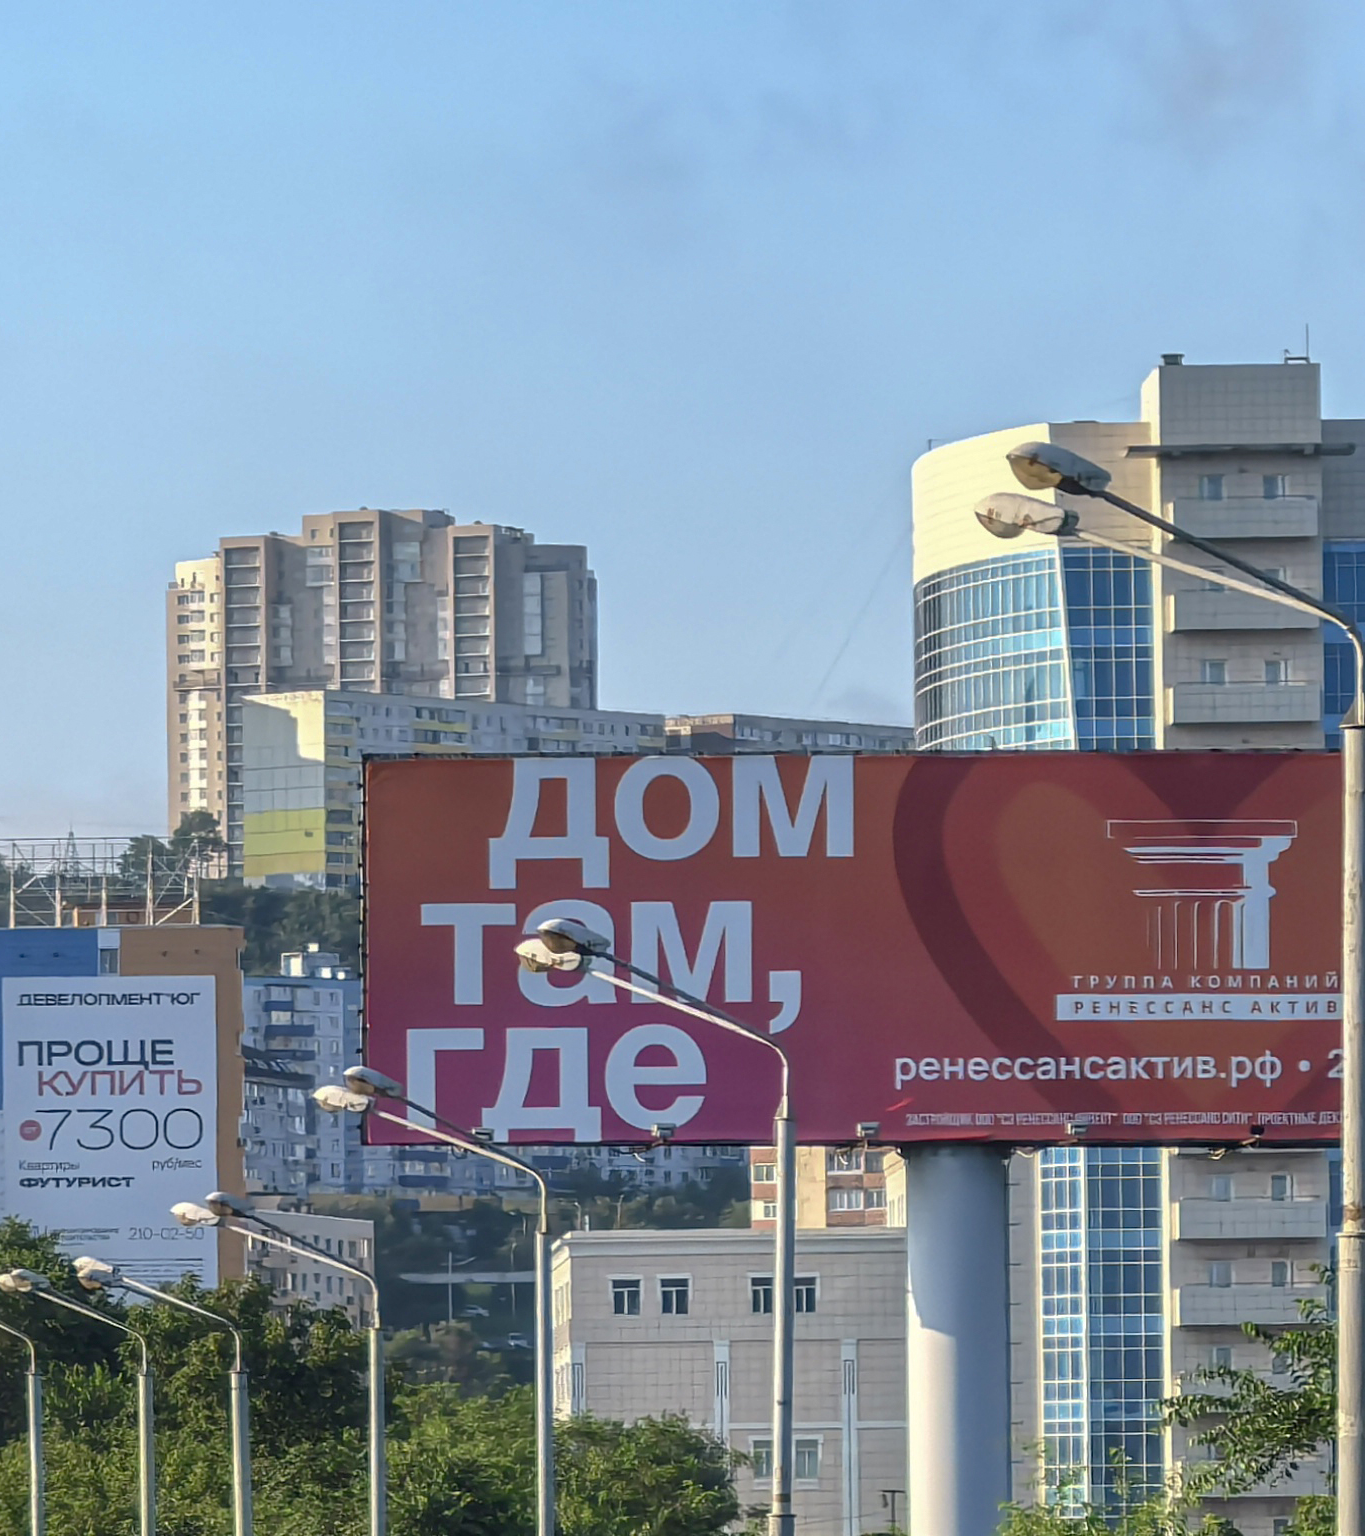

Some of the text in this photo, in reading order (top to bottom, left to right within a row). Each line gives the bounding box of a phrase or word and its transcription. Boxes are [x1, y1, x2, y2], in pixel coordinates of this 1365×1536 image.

[488, 755, 854, 889] дом
[420, 899, 801, 1034] там,
[1073, 971, 1339, 988] ГРУППА КОМПАНИЙ
[1074, 1000, 1338, 1015] РЕНЕССАНС АКТИВ
[18, 1039, 174, 1070] ПРОЩЕ
[895, 1051, 1282, 1089] ренессансактив.рф
[38, 1070, 203, 1096] КУПИТЬ
[406, 1023, 707, 1142] где
[35, 1108, 203, 1150] 7300
[19, 1176, 135, 1188] ФУТУРИСТ
